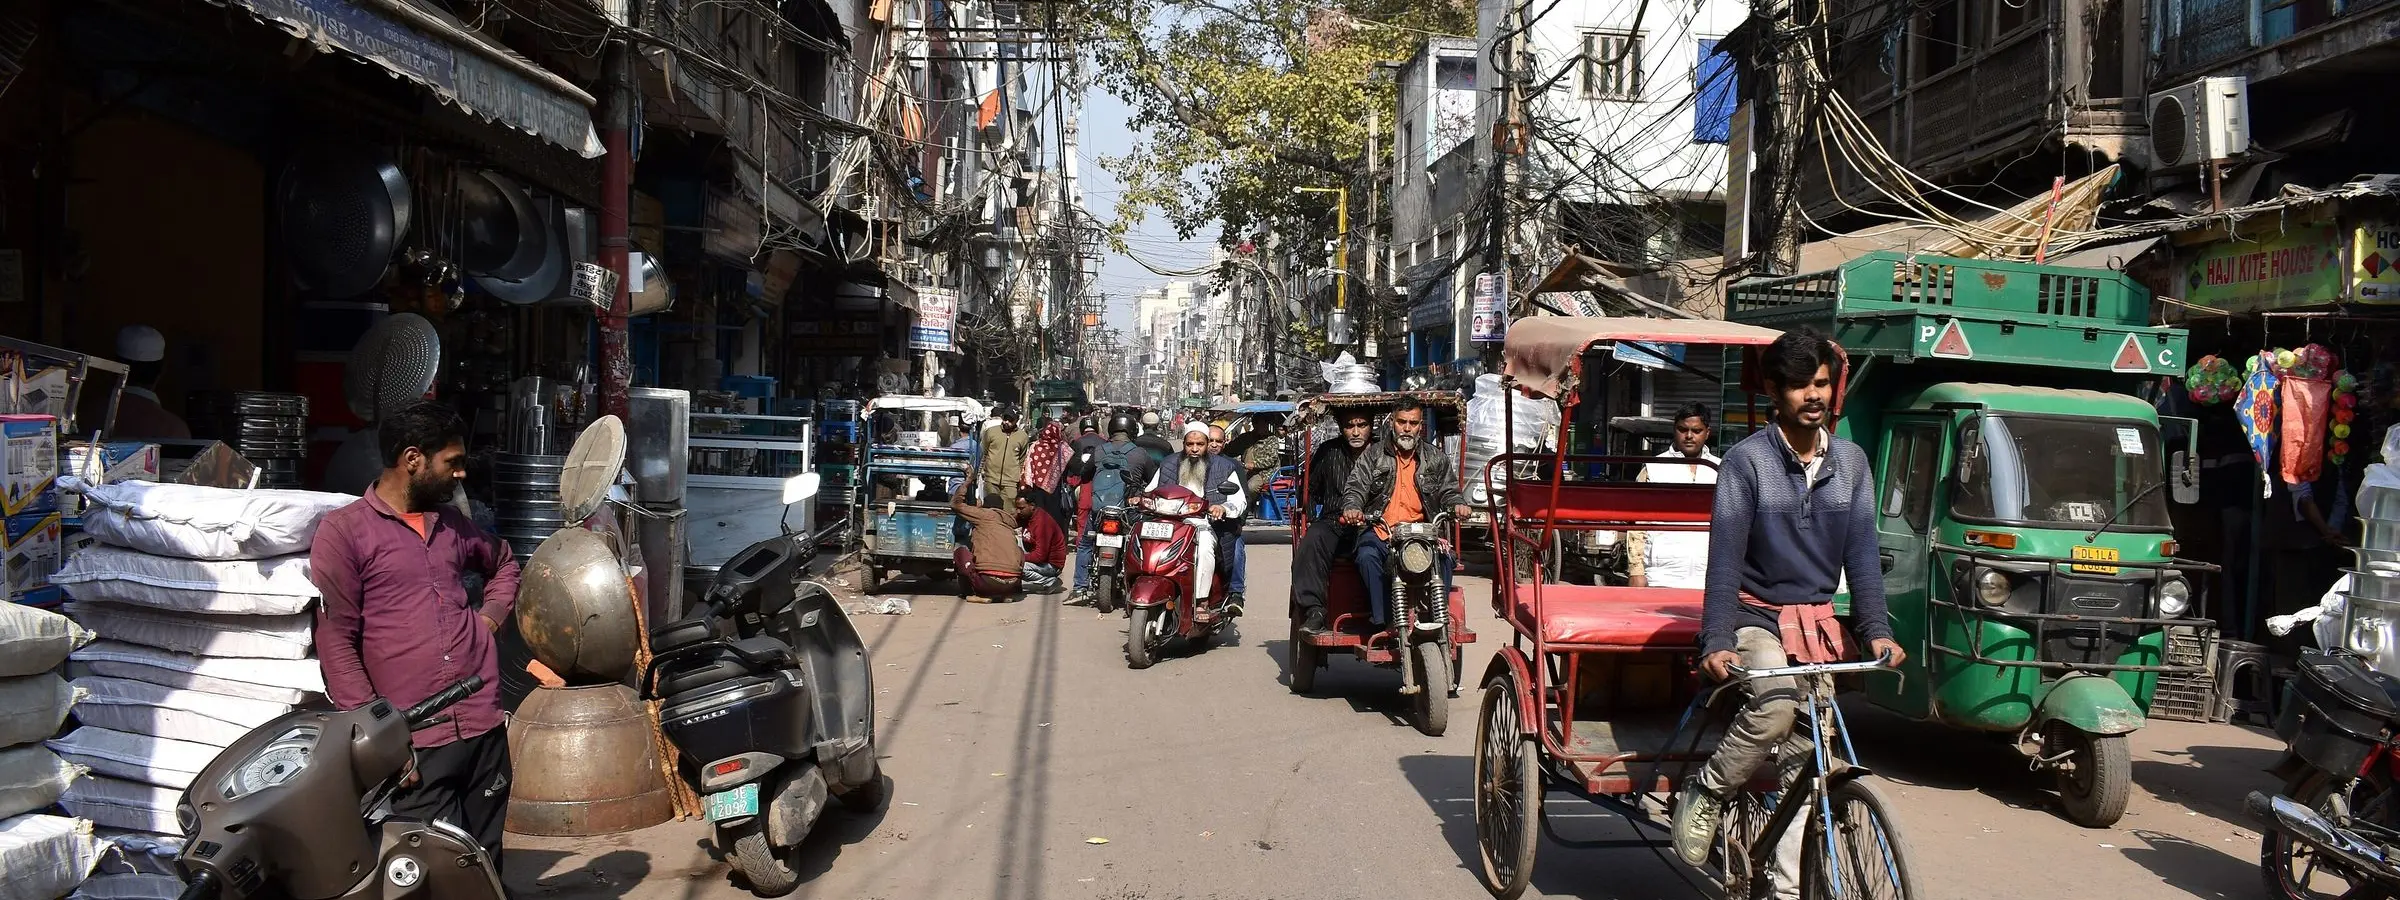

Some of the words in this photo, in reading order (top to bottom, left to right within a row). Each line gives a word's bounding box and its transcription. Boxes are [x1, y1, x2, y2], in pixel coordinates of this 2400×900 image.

[353, 29, 440, 76] EQUIPMENT
[2207, 256, 2235, 285] HAJI
[2239, 252, 2268, 282] KITE
[2271, 245, 2316, 278] HOUSE
[1920, 325, 1936, 343] P
[686, 709, 726, 724] ATHER
